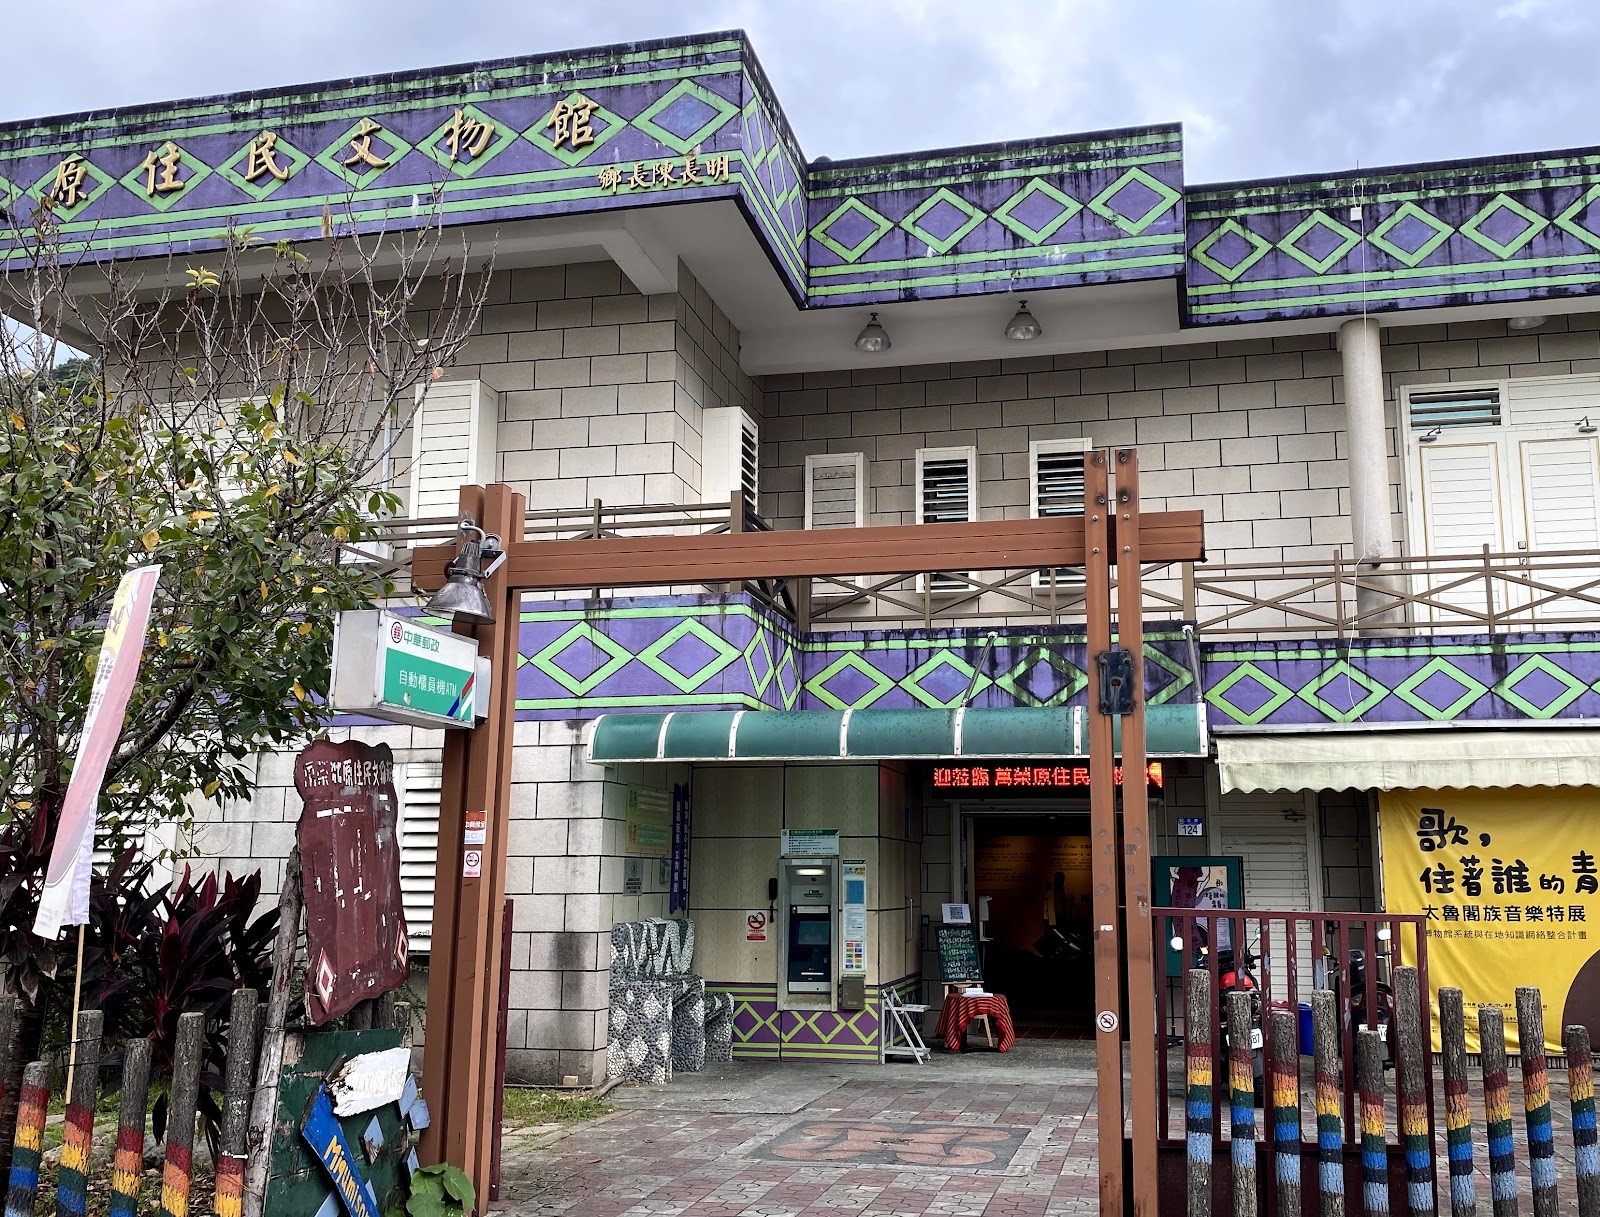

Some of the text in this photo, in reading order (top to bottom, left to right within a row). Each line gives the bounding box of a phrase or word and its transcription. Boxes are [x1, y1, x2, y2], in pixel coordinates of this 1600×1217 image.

[50, 95, 600, 207] 原住民文物館
[598, 154, 730, 194] 鄉長陳長明
[403, 629, 441, 654] 中華郵政
[1182, 825, 1198, 835] 124
[1421, 904, 1587, 923] 太魯閣族音樂特展
